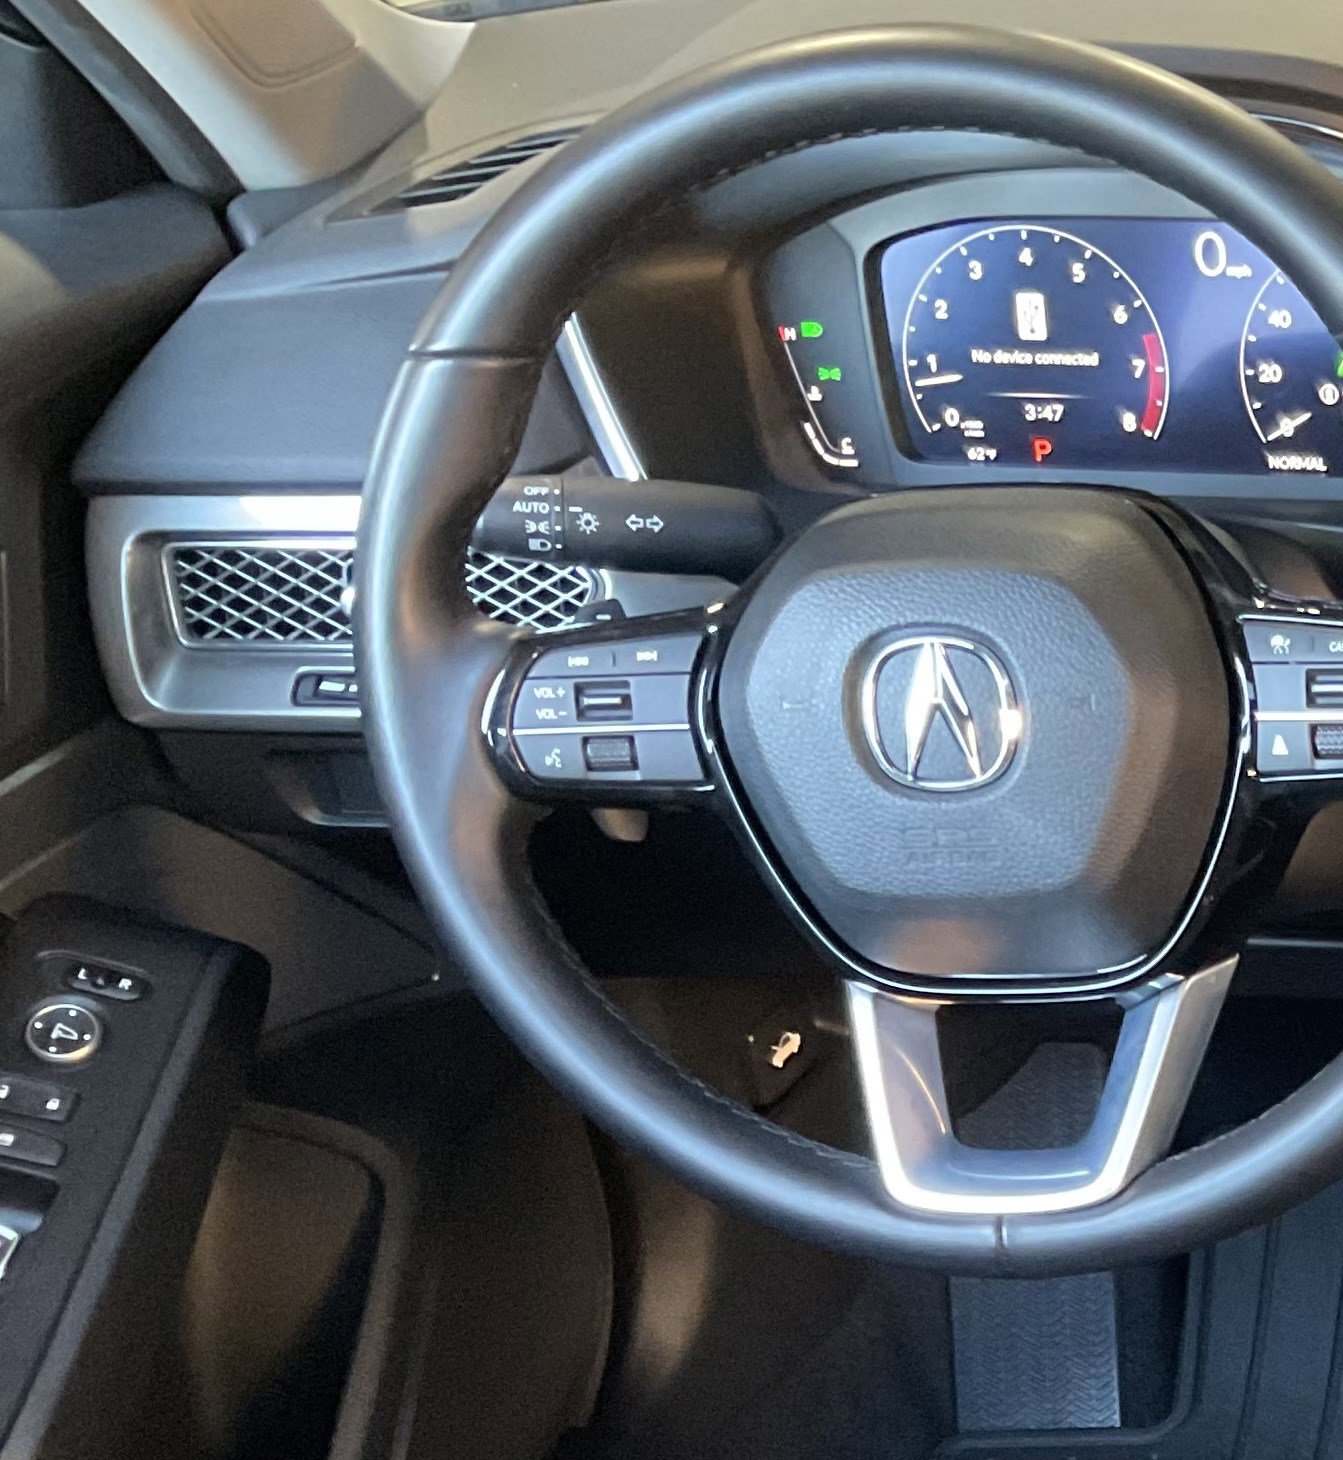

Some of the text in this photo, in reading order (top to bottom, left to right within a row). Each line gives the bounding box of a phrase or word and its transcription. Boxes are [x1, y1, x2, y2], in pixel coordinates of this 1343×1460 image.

[1019, 247, 1035, 267] 4
[1195, 231, 1227, 277] 0
[968, 260, 983, 281] 3
[1072, 262, 1086, 284] 5
[934, 299, 949, 320] 2
[1113, 305, 1128, 325] 6
[1268, 310, 1292, 330] 40
[926, 354, 938, 373] 1
[971, 349, 1100, 367] No device connected
[1131, 358, 1146, 379] 7
[1257, 363, 1284, 384] 20
[943, 406, 961, 428] 0
[1024, 403, 1065, 422] 3:47
[1122, 411, 1137, 433] 8
[1032, 438, 1053, 463] P
[1267, 455, 1328, 473] NORMAL
[523, 485, 550, 497] OFF
[512, 500, 550, 514] AUTO
[533, 687, 557, 699] VOL
[535, 708, 557, 720] VOL
[77, 968, 88, 980] L
[118, 978, 133, 991] R
